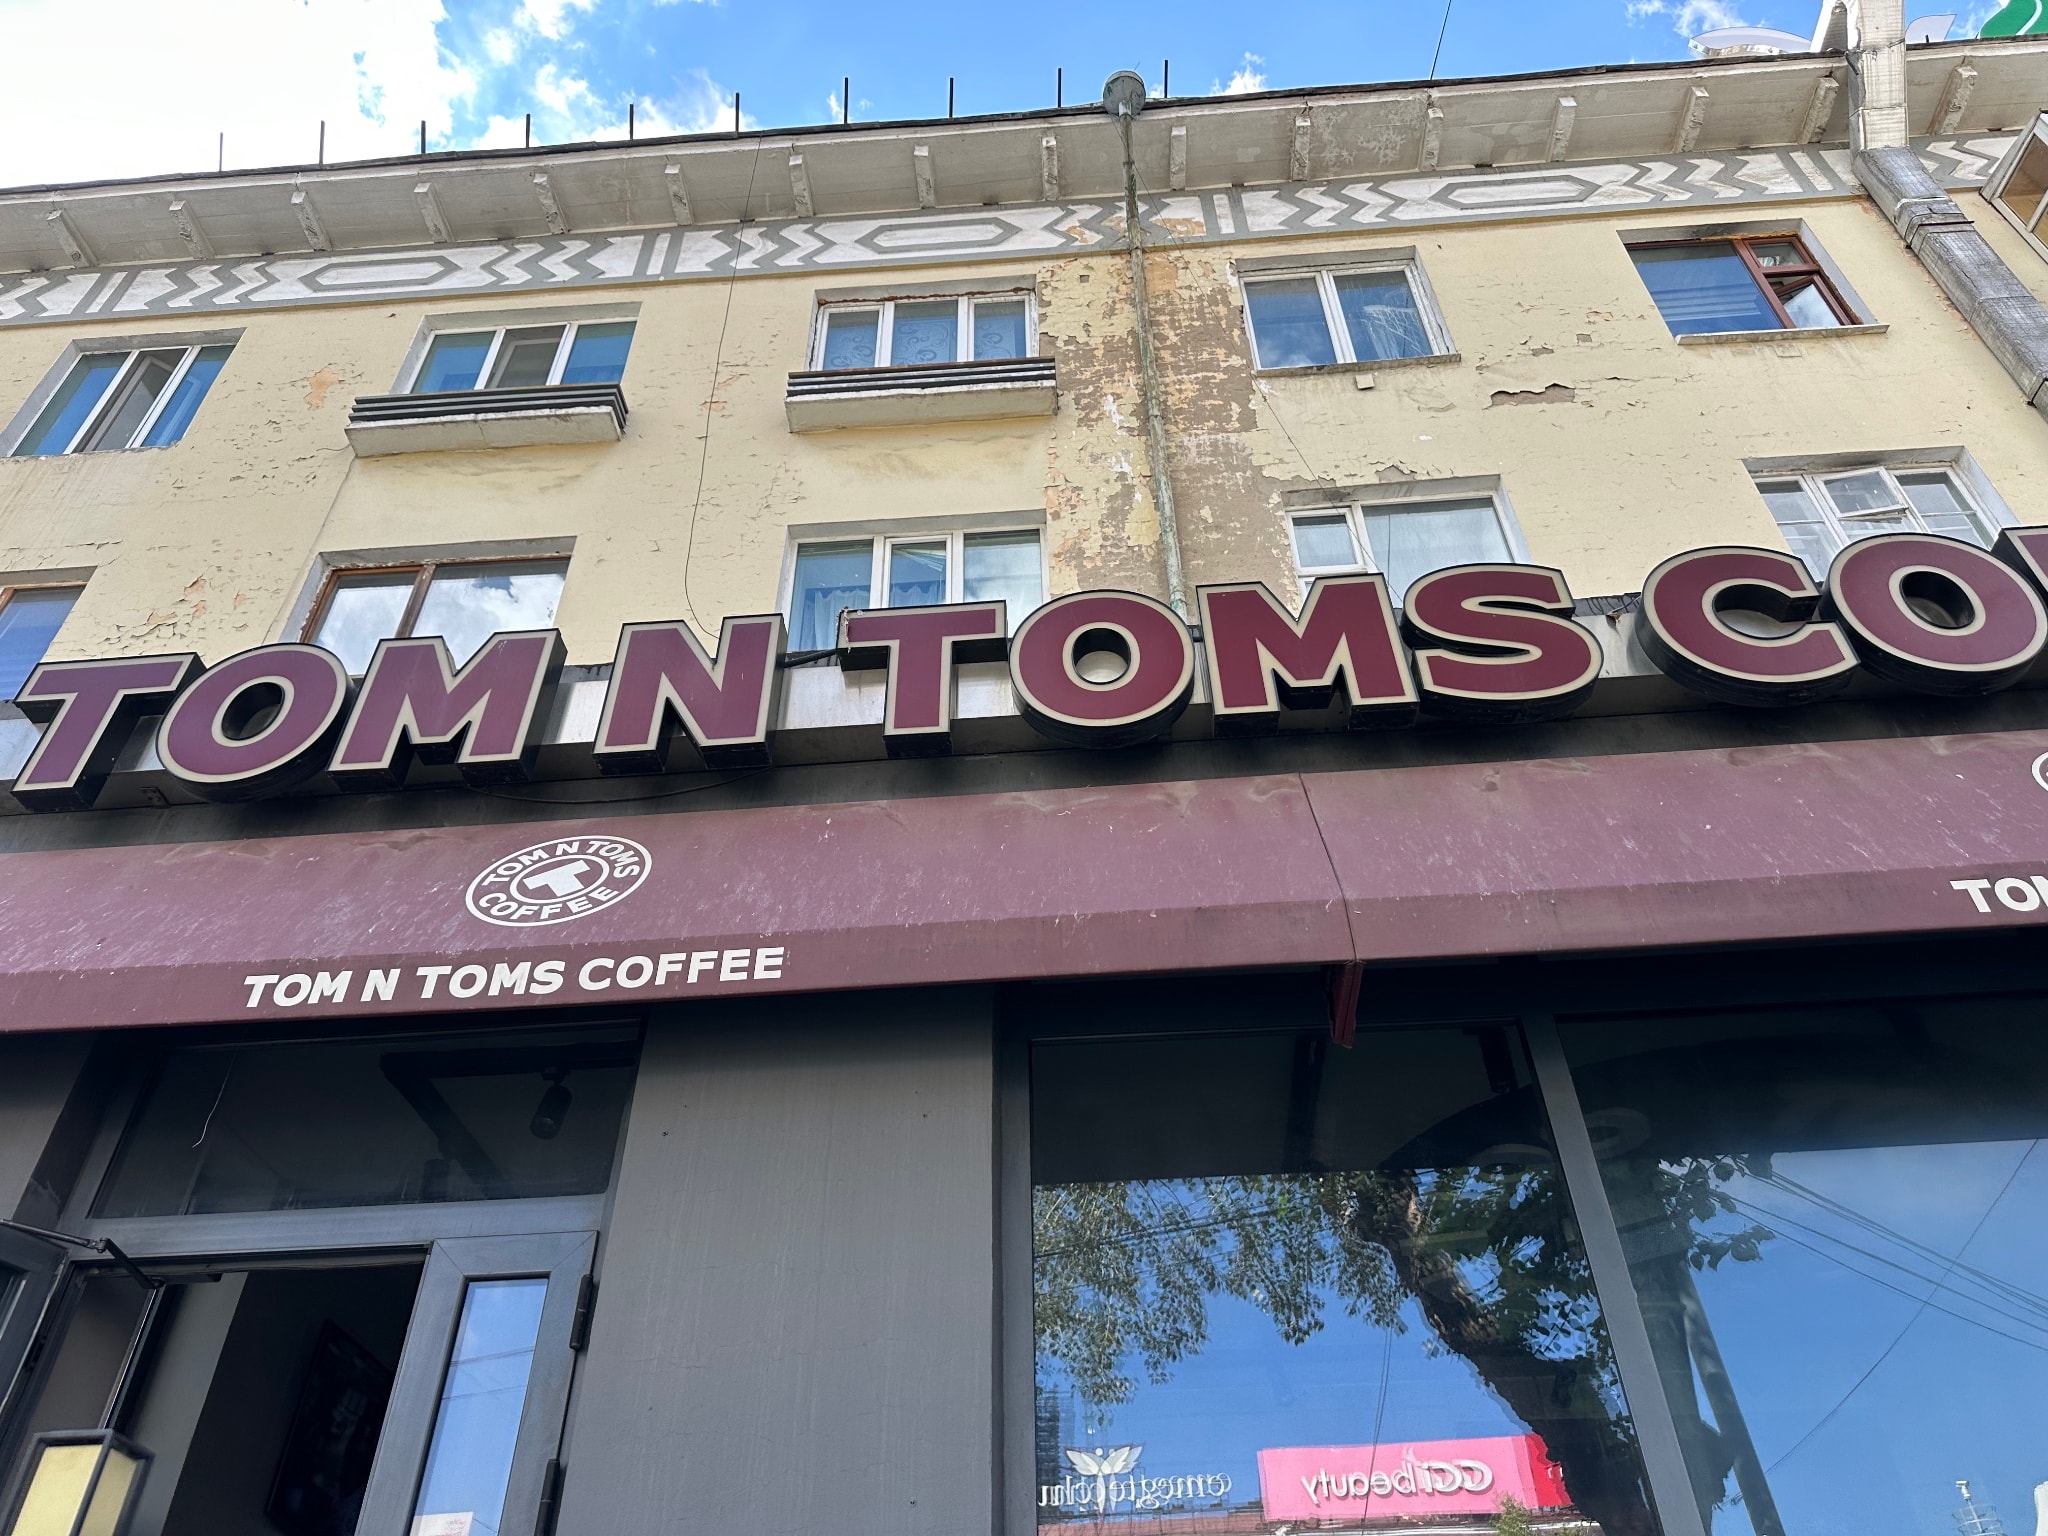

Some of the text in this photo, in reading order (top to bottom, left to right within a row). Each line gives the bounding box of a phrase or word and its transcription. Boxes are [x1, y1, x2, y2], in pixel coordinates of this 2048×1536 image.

[11, 524, 2048, 796] TOM N TOMS CO
[481, 840, 641, 886] TOM N TOMS
[478, 886, 620, 920] COFFEE
[1949, 875, 2048, 913] TO
[242, 946, 786, 1009] TOM N TOMS COFFEE
